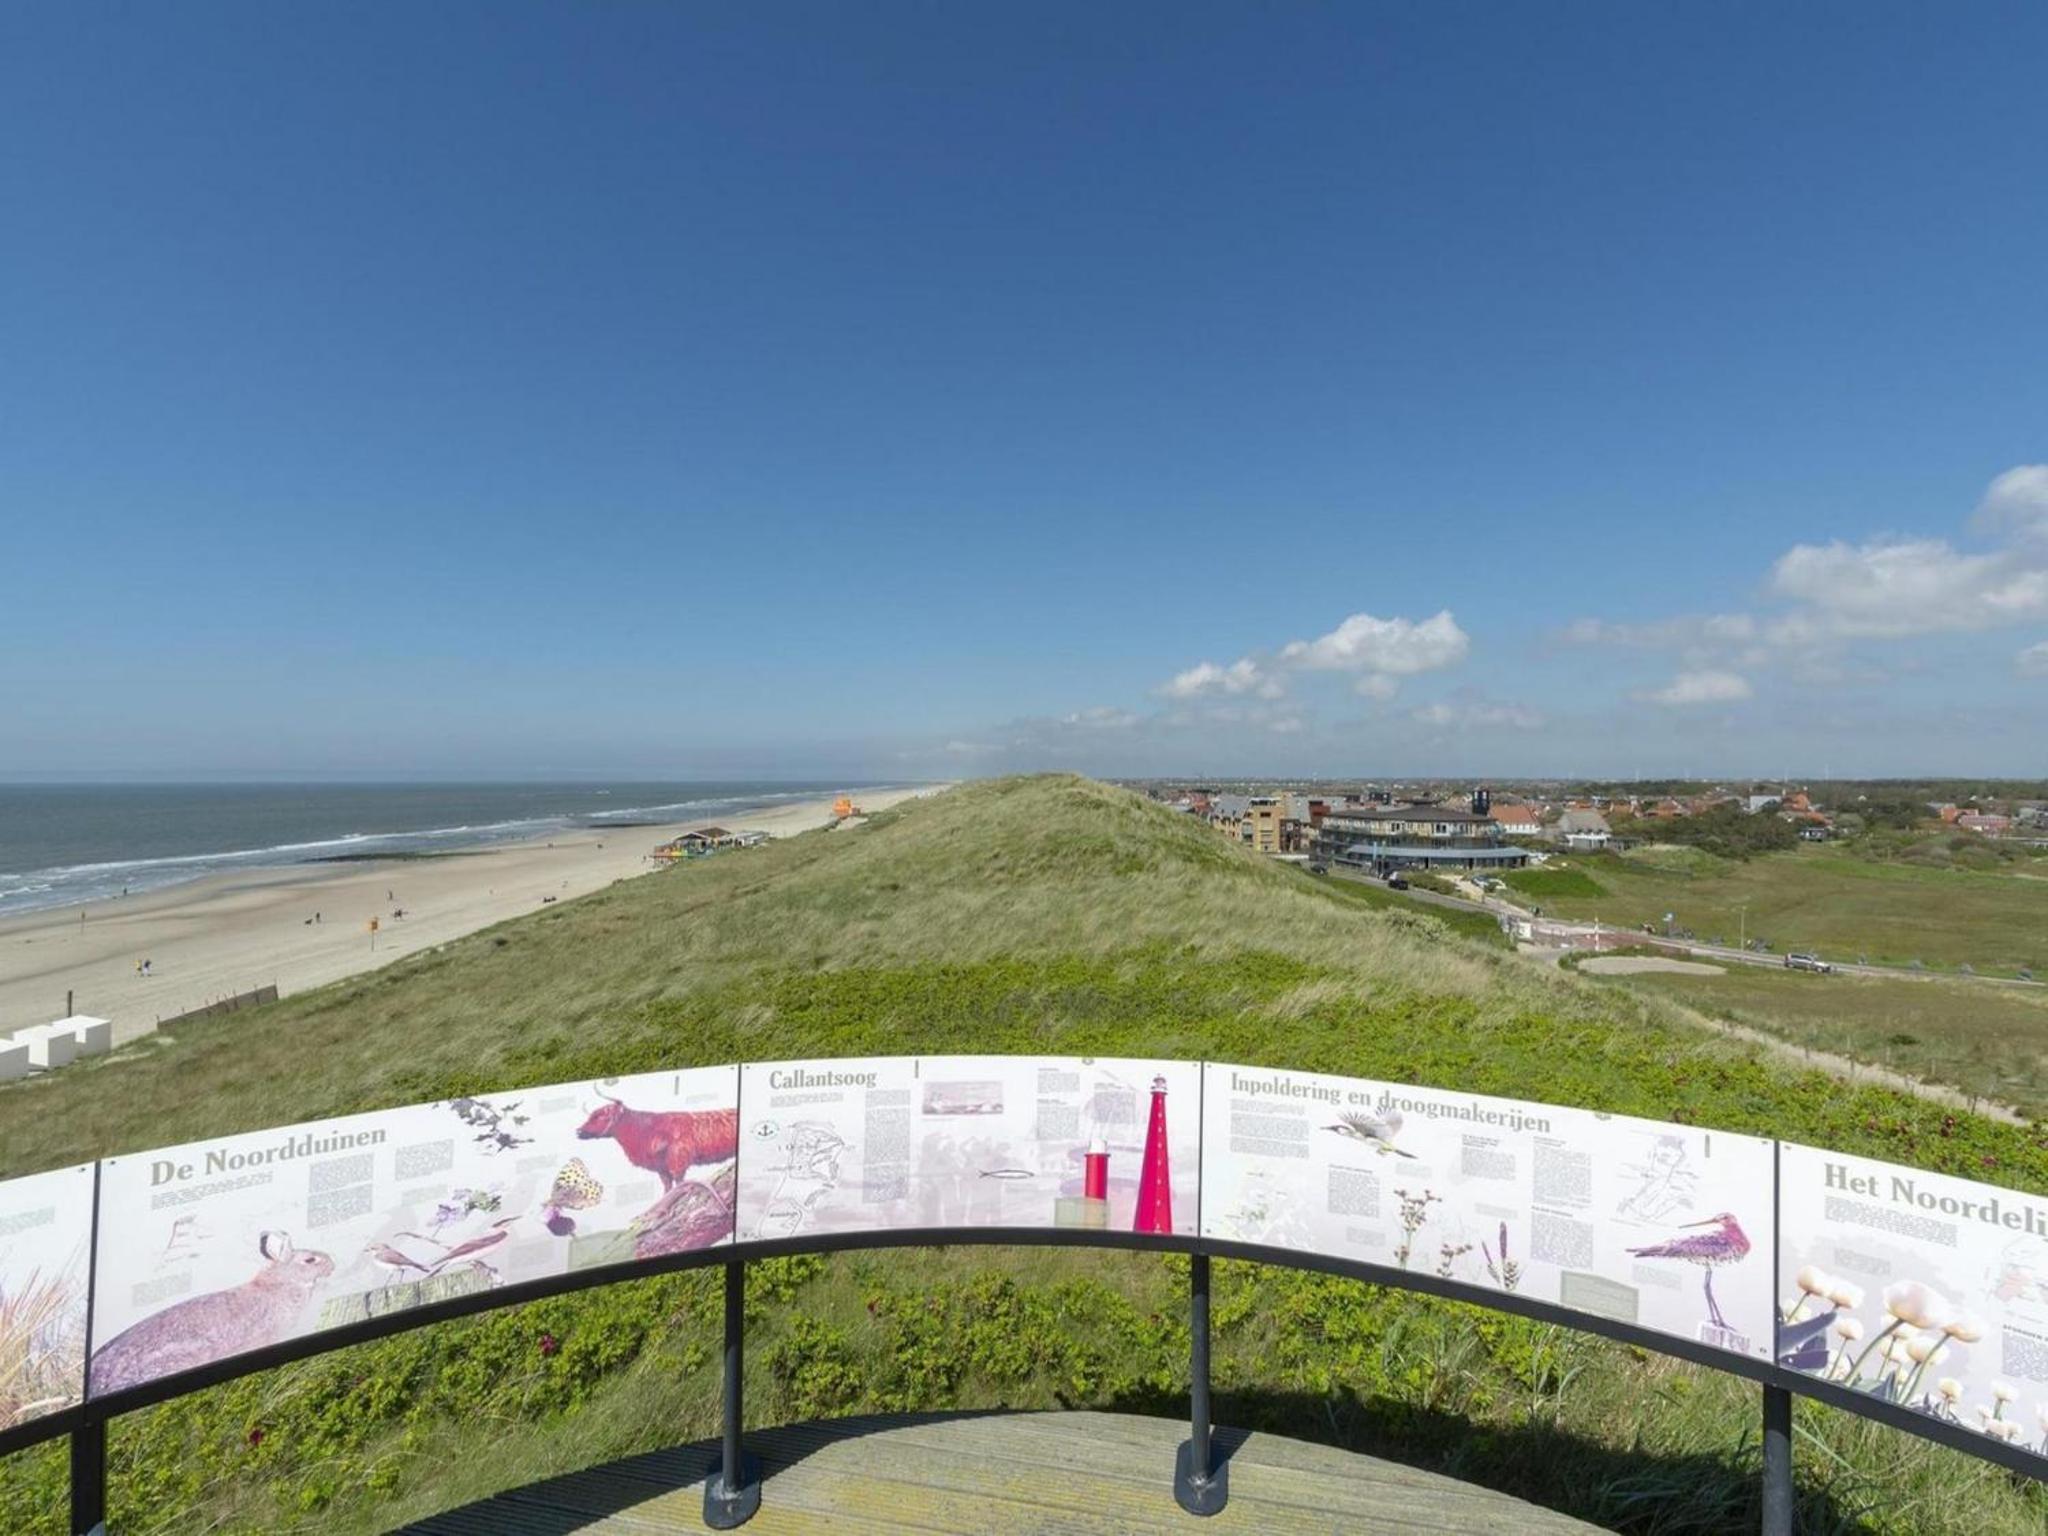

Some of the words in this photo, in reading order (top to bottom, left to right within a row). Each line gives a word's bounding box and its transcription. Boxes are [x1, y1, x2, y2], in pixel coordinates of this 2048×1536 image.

[769, 1069, 878, 1090] Callantsoog
[1231, 1072, 1342, 1105] Inpoldering
[1348, 1091, 1372, 1107] en
[1378, 1090, 1552, 1134] droogmakerijen
[150, 1159, 194, 1187] De
[205, 1128, 388, 1175] Noordduinen
[1824, 1163, 1880, 1198] Het
[1890, 1176, 2048, 1243] Noordeli
